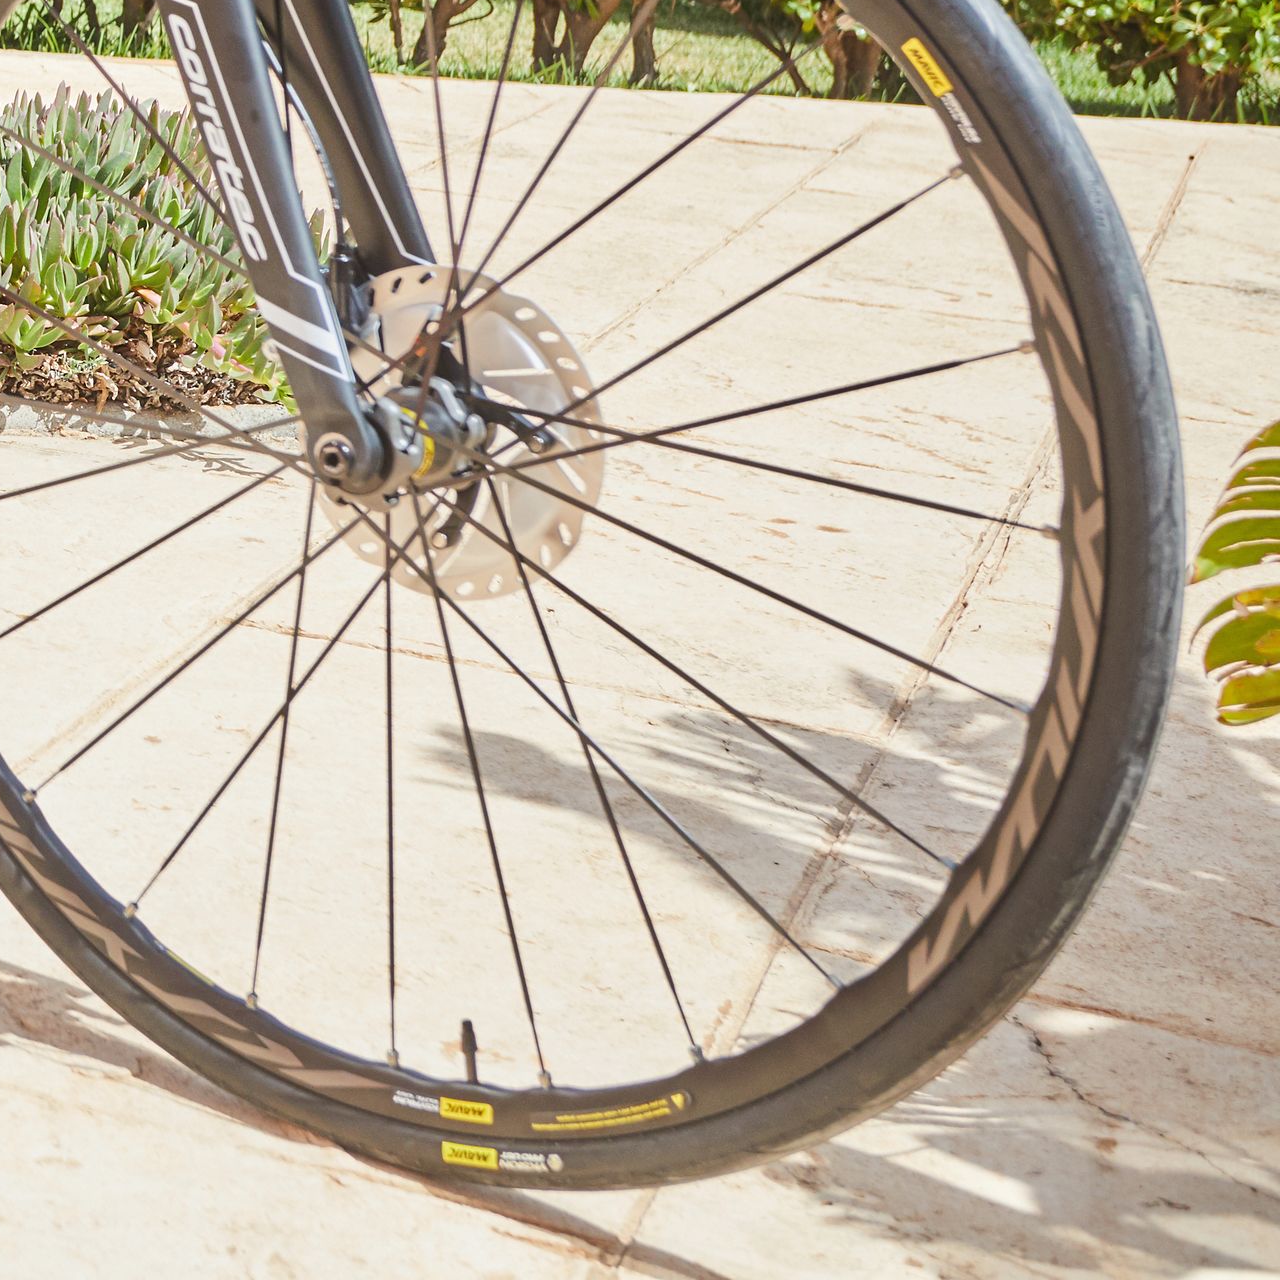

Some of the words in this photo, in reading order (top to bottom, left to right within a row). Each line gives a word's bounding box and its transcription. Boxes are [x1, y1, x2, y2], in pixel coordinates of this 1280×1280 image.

[909, 48, 946, 88] MAVIC
[167, 12, 269, 263] corratec
[444, 1102, 485, 1117] MAVIC
[448, 1147, 490, 1163] MAVIC
